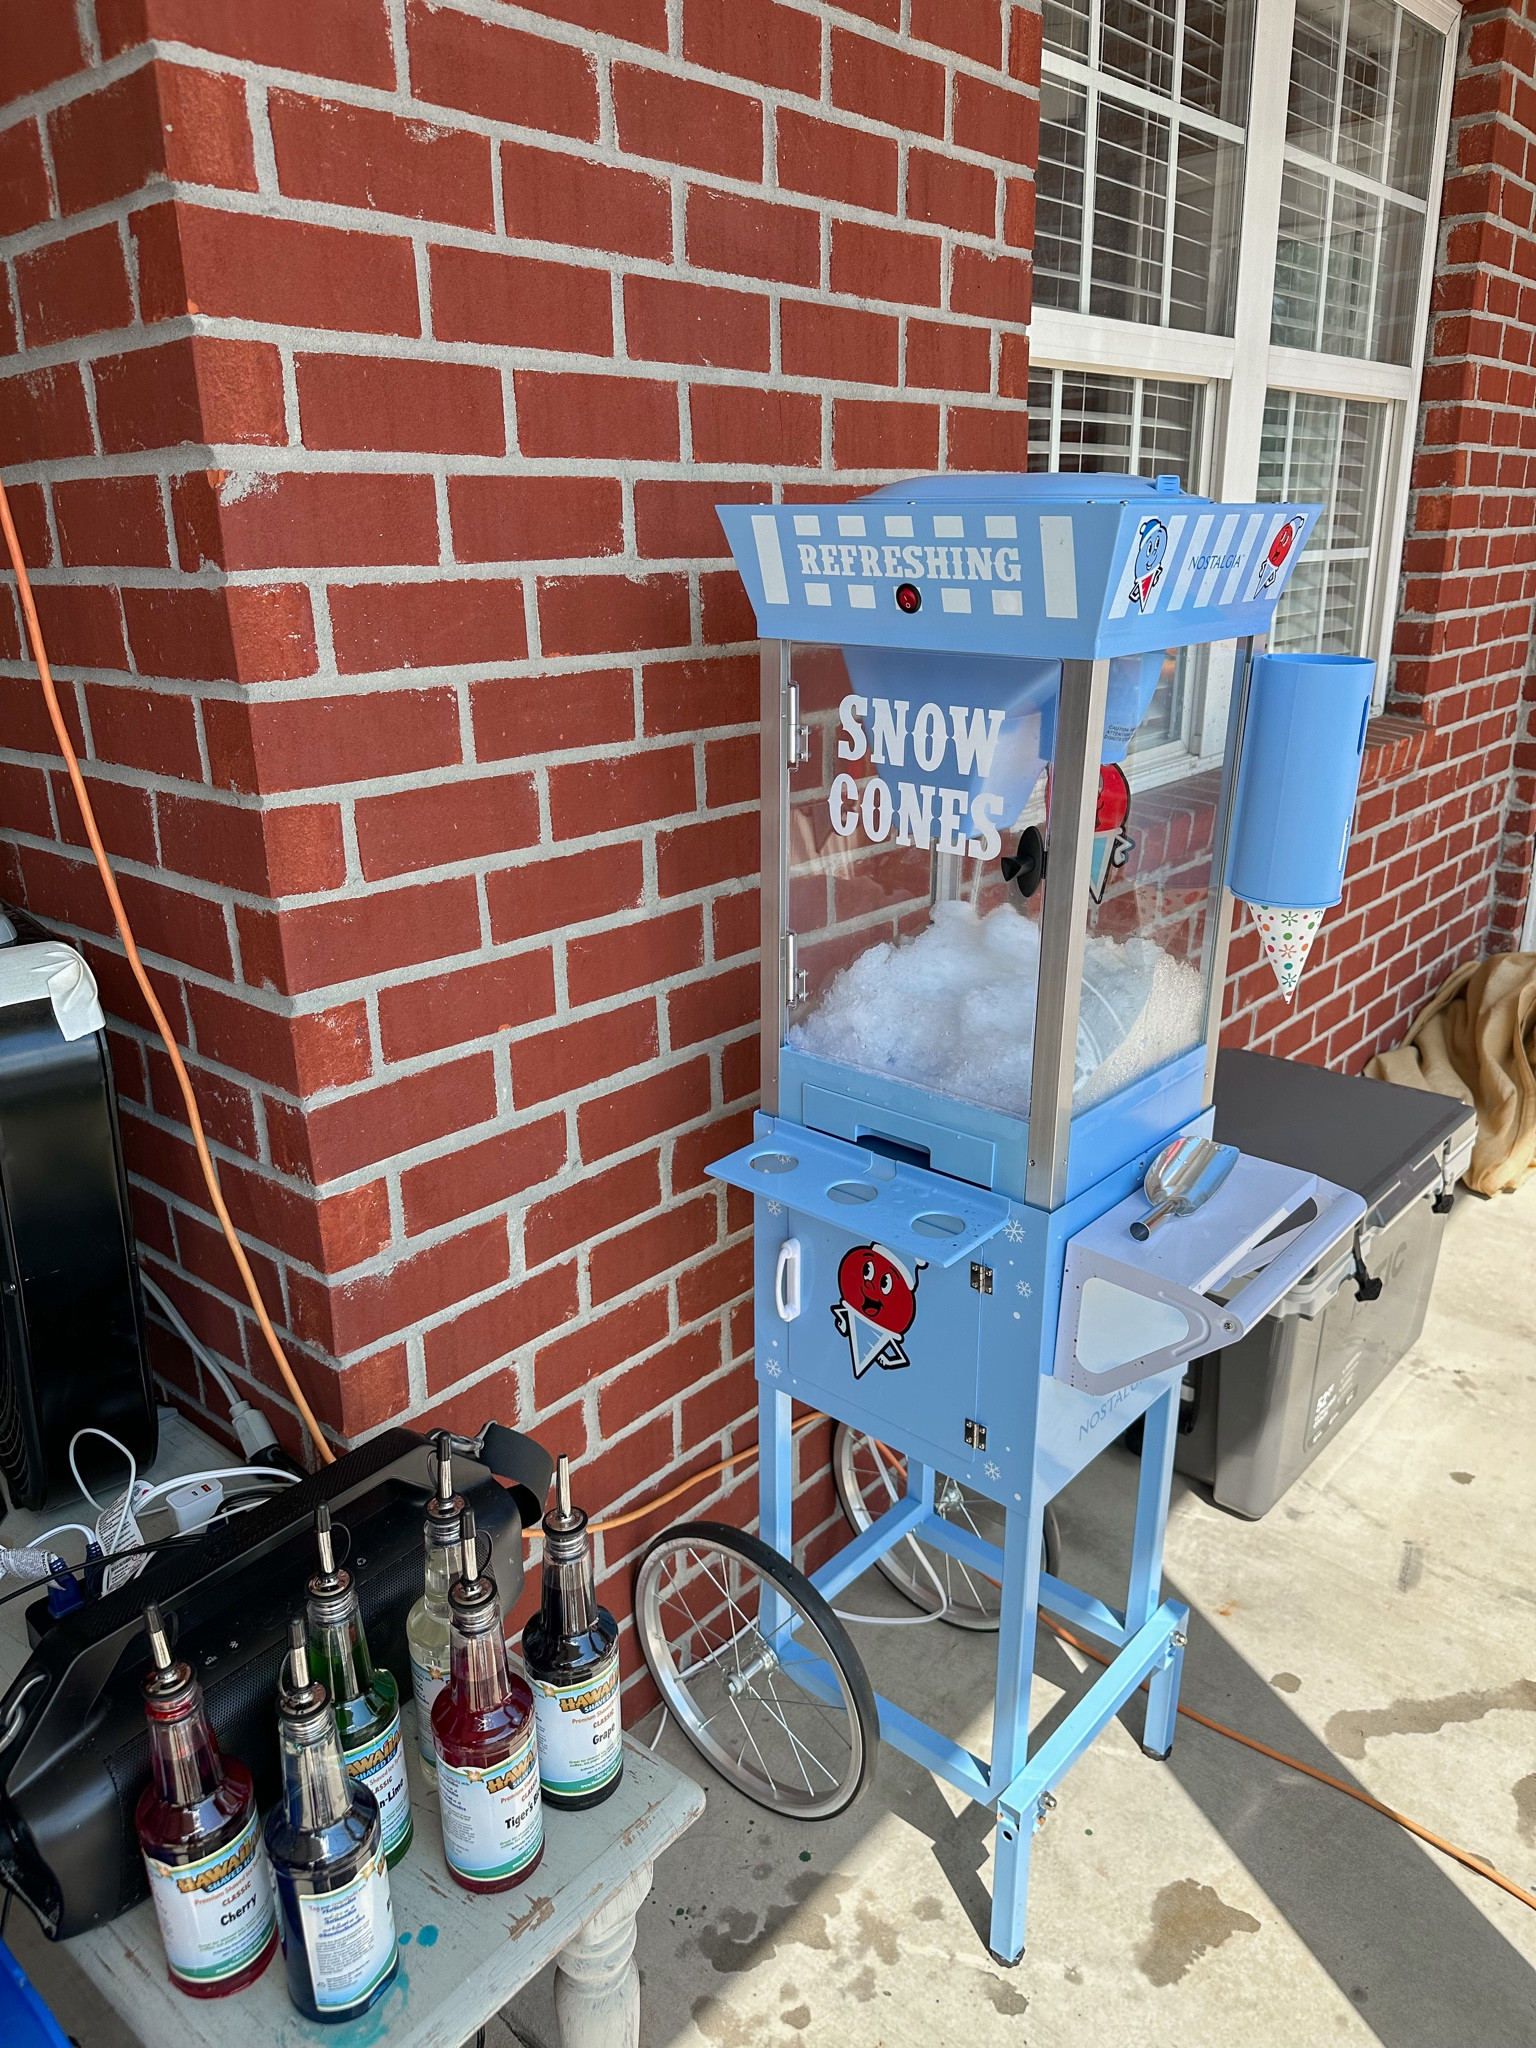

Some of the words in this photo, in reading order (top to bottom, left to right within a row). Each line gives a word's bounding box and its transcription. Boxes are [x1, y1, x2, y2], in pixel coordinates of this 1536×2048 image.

[797, 544, 1021, 581] REFRESHING
[1188, 555, 1241, 570] NOSTALGIA
[838, 694, 1006, 778] SNOW
[827, 772, 1005, 861] CONES
[1078, 1380, 1144, 1442] NOSTAL
[584, 1693, 611, 1713] SHAVED
[592, 1723, 616, 1746] Grape
[372, 1775, 393, 1795] LASSIC
[379, 1778, 404, 1808] n-Lime
[504, 1801, 533, 1829] Tiger's
[206, 1865, 244, 1891] SHAVED
[194, 1891, 225, 1906] Premium
[222, 1880, 252, 1907] CLASSIC
[220, 1893, 257, 1926] Cherry
